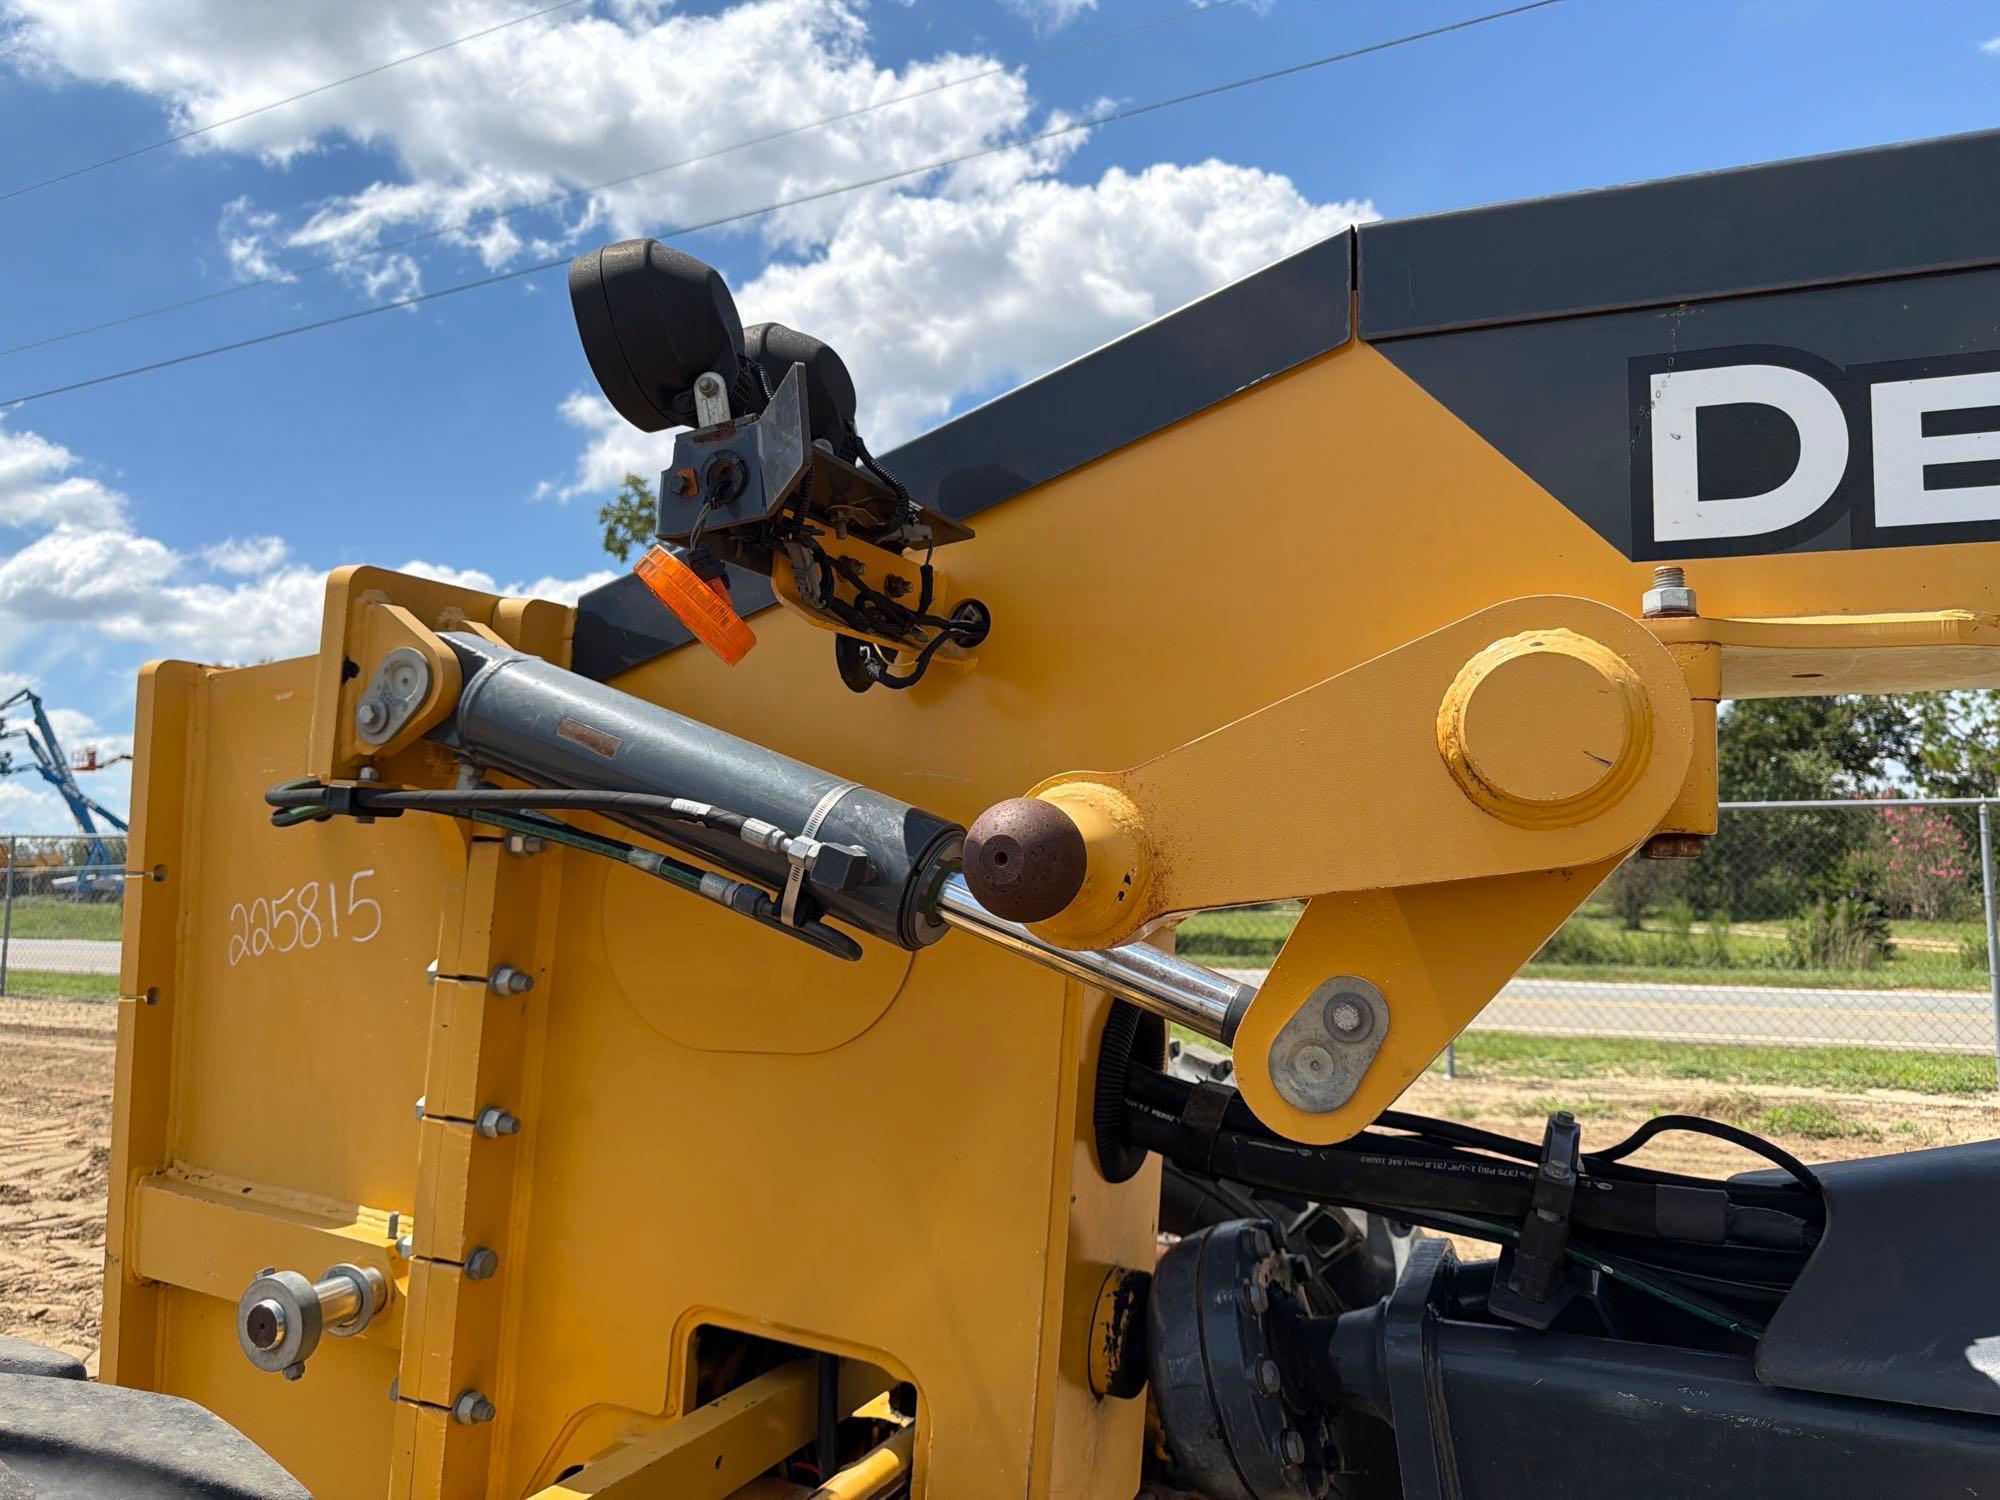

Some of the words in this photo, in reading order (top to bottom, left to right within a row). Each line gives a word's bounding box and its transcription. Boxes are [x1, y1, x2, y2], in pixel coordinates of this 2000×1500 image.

[1650, 364, 2000, 542] DE
[229, 869, 382, 966] 225815
[1386, 1158, 1402, 1166] SAE
